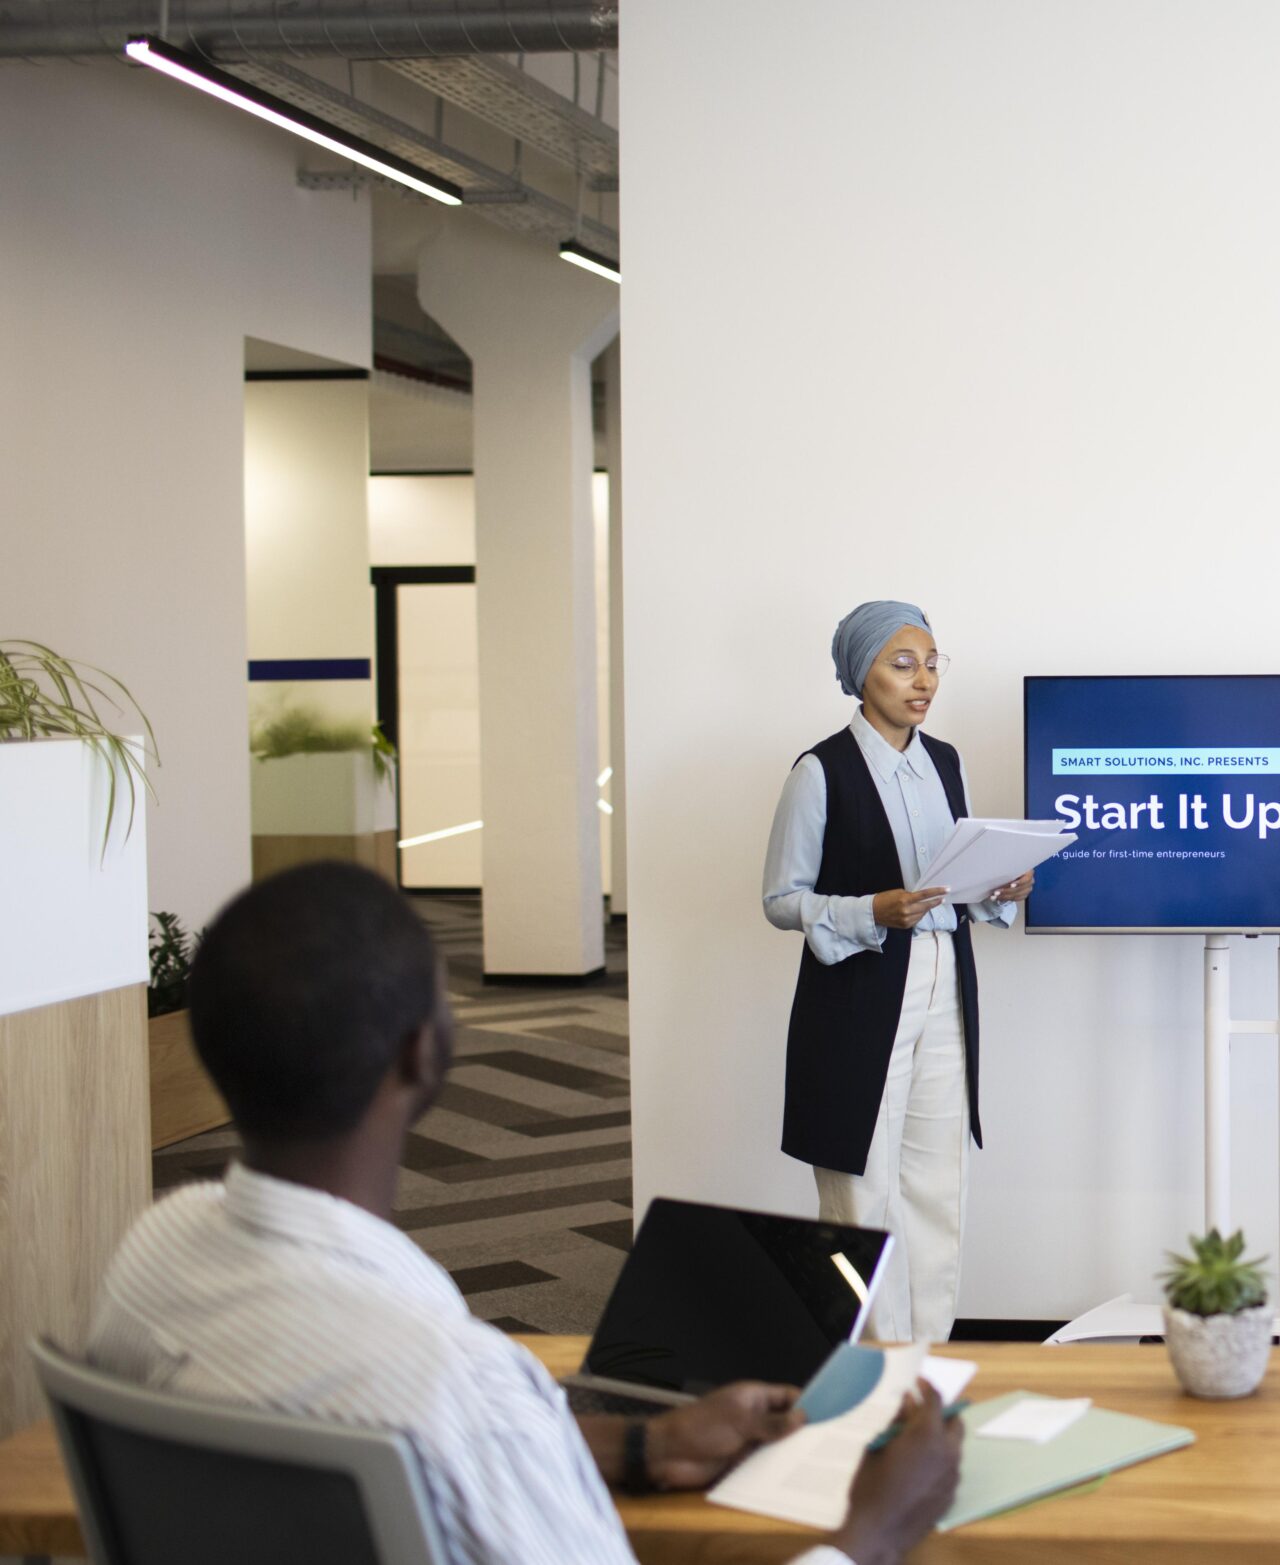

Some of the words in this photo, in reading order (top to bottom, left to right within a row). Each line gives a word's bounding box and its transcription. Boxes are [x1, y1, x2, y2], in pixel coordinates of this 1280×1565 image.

[1060, 757, 1101, 767] SMART
[1104, 757, 1177, 768] SOLUTIONS,
[1180, 757, 1204, 767] INC.
[1207, 756, 1269, 766] PRESENTS
[1054, 793, 1165, 830] Start
[1179, 793, 1209, 830] It
[1062, 850, 1090, 860] guide
[1092, 849, 1106, 858] for
[1109, 849, 1154, 858] first-time
[1156, 849, 1226, 860] entrepreneurs
